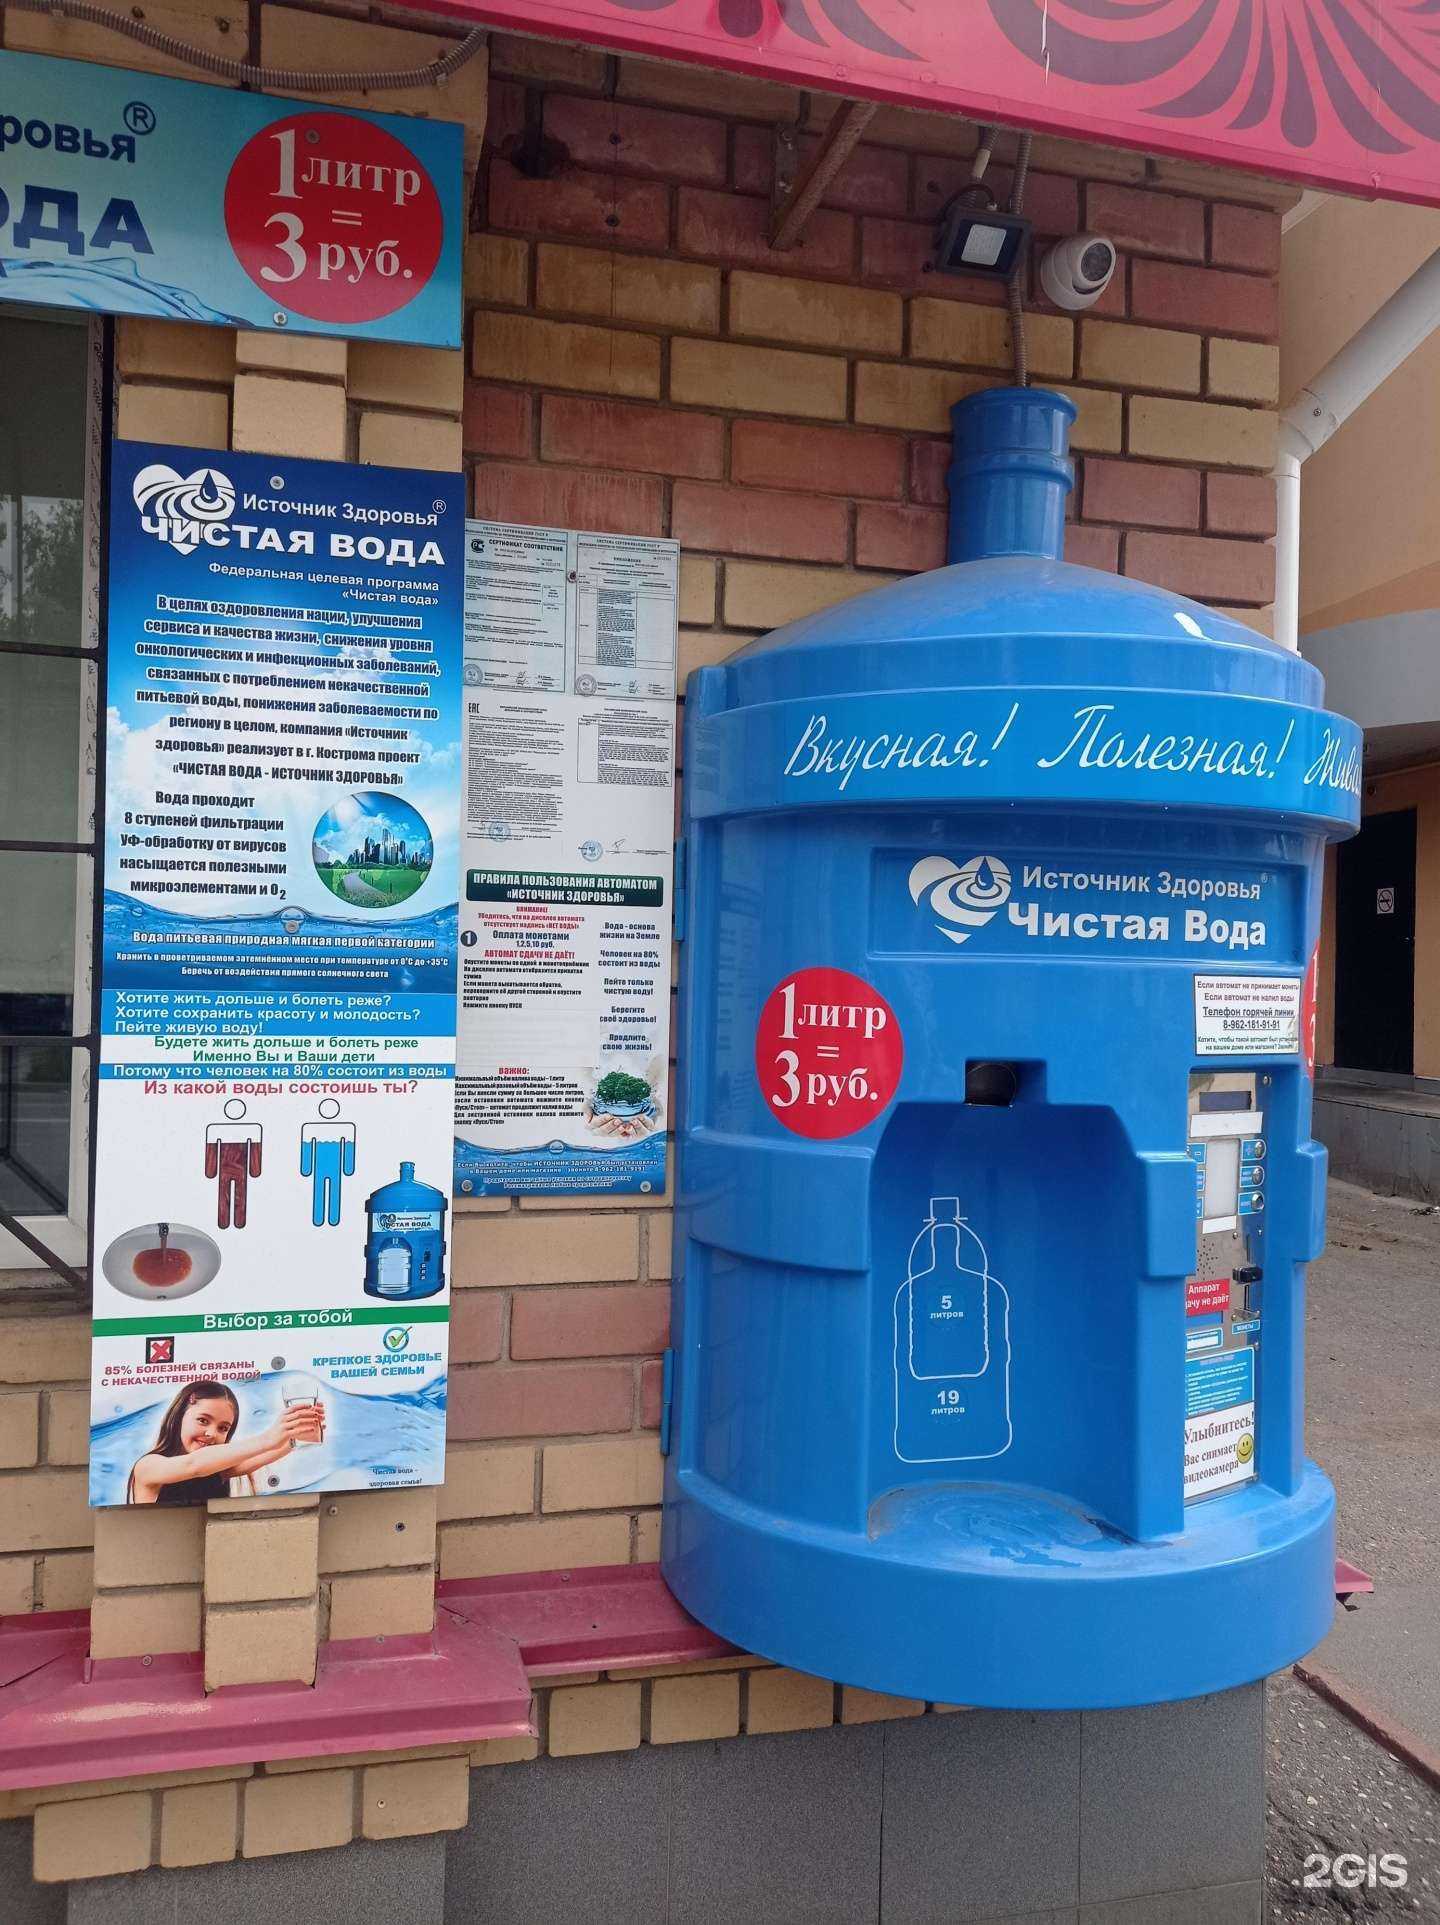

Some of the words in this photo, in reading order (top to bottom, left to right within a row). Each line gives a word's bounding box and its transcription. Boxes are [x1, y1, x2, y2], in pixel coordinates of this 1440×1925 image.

[269, 128, 303, 199] 1
[301, 156, 421, 206] литр
[0, 185, 154, 256] ДА
[260, 212, 307, 283] 3
[317, 240, 413, 284] руб.
[243, 493, 337, 518] Источник
[342, 503, 438, 526] Здоровья
[141, 516, 314, 555] ЧИСТАЯ
[330, 532, 445, 568] ВОДА
[209, 563, 303, 579] Федеральная
[307, 573, 362, 584] целевая
[367, 578, 438, 590] программа
[342, 589, 396, 601] «Чистая
[400, 595, 438, 605] вода»
[158, 596, 168, 609] В
[169, 597, 208, 613] целях
[210, 602, 304, 620] оздоровления
[306, 608, 349, 625] нации,
[351, 612, 422, 629] улучшения
[144, 619, 200, 635] сервиса
[203, 625, 211, 635] и
[214, 625, 273, 641] качества
[275, 630, 320, 646] жизни,
[324, 633, 388, 649] снижения
[389, 637, 433, 653] уровня
[784, 702, 1019, 791] Вкусная!
[1036, 704, 1295, 779] Полезная!
[1303, 728, 1361, 798] Жива
[172, 762, 225, 775] «ЧИСТАЯ
[228, 764, 262, 779] ВОДА
[271, 767, 333, 781] ИСТОЧНИК
[335, 770, 402, 784] ЗДОРОВЬЯ»
[155, 791, 189, 805] Вода
[192, 794, 255, 808] проходит
[124, 811, 132, 824] 8
[135, 814, 197, 826] ступеней
[200, 816, 283, 830] фильтрации
[120, 834, 213, 850] УФ-обработку
[216, 839, 231, 850] от
[233, 840, 286, 852] вирусов
[119, 858, 206, 871] насыщается
[208, 861, 286, 873] полезными
[130, 881, 256, 894] микроэлементами
[259, 884, 267, 895] и
[473, 873, 520, 884] ПРАВИЛА
[522, 875, 595, 887] ПОЛЬЗОВАНИЯ
[596, 877, 656, 889] АВТОМАТОМ
[1022, 865, 1151, 893] Источник
[1157, 871, 1261, 901] Здоровья
[506, 888, 564, 900] «ИСТОЧНИК
[566, 890, 624, 902] ЗДОРОВЬЯ»
[1008, 902, 1170, 941] Чистая
[1184, 909, 1266, 950] Вода
[133, 931, 164, 945] Вода
[165, 932, 222, 946] питьевая
[224, 934, 291, 948] природная
[291, 936, 332, 948] мягкая
[334, 936, 376, 949] первой
[378, 938, 436, 951] категории
[492, 930, 523, 940] Оплата
[525, 932, 569, 941] монетами
[115, 991, 169, 1003] Хотите
[173, 994, 211, 1003] жить
[214, 995, 274, 1005] дольше
[278, 996, 287, 1004] и
[291, 993, 343, 1005] болеть
[347, 994, 391, 1007] реже?
[114, 1005, 168, 1021] Хотите
[173, 1009, 253, 1020] сохранить
[257, 1010, 315, 1021] красоту
[319, 1010, 328, 1019] и
[333, 1008, 420, 1021] молодость?
[778, 982, 799, 1039] 1
[797, 1004, 887, 1039] литр
[1202, 1006, 1240, 1017] Телефон
[1241, 1007, 1272, 1016] горячей
[115, 1020, 161, 1035] Пейте
[165, 1023, 219, 1036] живую
[220, 1021, 262, 1036] воду!
[193, 1050, 251, 1064] Именно
[256, 1050, 279, 1064] Вы
[284, 1053, 292, 1064] и
[297, 1050, 337, 1065] Ваши
[340, 1053, 374, 1065] дети
[113, 1064, 171, 1078] Потому
[175, 1067, 201, 1075] что
[206, 1067, 267, 1075] человек
[272, 1067, 288, 1075] на
[293, 1064, 323, 1076] 80%
[327, 1067, 384, 1075] состоит
[388, 1067, 404, 1075] из
[408, 1067, 446, 1077] воды
[772, 1050, 801, 1107] 3
[806, 1067, 878, 1106] руб.
[144, 1080, 167, 1094] Из
[173, 1080, 226, 1093] какой
[232, 1083, 282, 1095] воды
[288, 1083, 377, 1093] состоишь
[382, 1079, 417, 1093] ты?
[1188, 1284, 1220, 1294] Аппарат
[941, 1295, 952, 1310] 5
[203, 1314, 267, 1330] Выбор
[273, 1314, 293, 1325] за
[298, 1308, 353, 1324] тобой
[930, 1311, 964, 1320] литров
[312, 1355, 371, 1366] КРЕПКОЕ
[374, 1352, 441, 1364] ЗДОРОВЬЕ
[104, 1365, 132, 1375] 85%
[136, 1362, 196, 1373] БОЛЕЗНЕЙ
[199, 1360, 256, 1373] СВЯЗАНЫ
[330, 1366, 377, 1378] ВАШЕЙ
[380, 1366, 424, 1375] СЕМЬИ
[101, 1378, 108, 1386] С
[112, 1372, 219, 1385] НЕКАЧЕСТВЕННОЙ
[221, 1371, 261, 1382] ВОДОЙ
[937, 1390, 960, 1405] 19
[931, 1406, 965, 1415] литров
[1184, 1411, 1255, 1445] Улыбнитесь!
[1184, 1454, 1200, 1467] Вас
[1201, 1443, 1238, 1462] снимает
[1184, 1459, 1239, 1485] видеокамера
